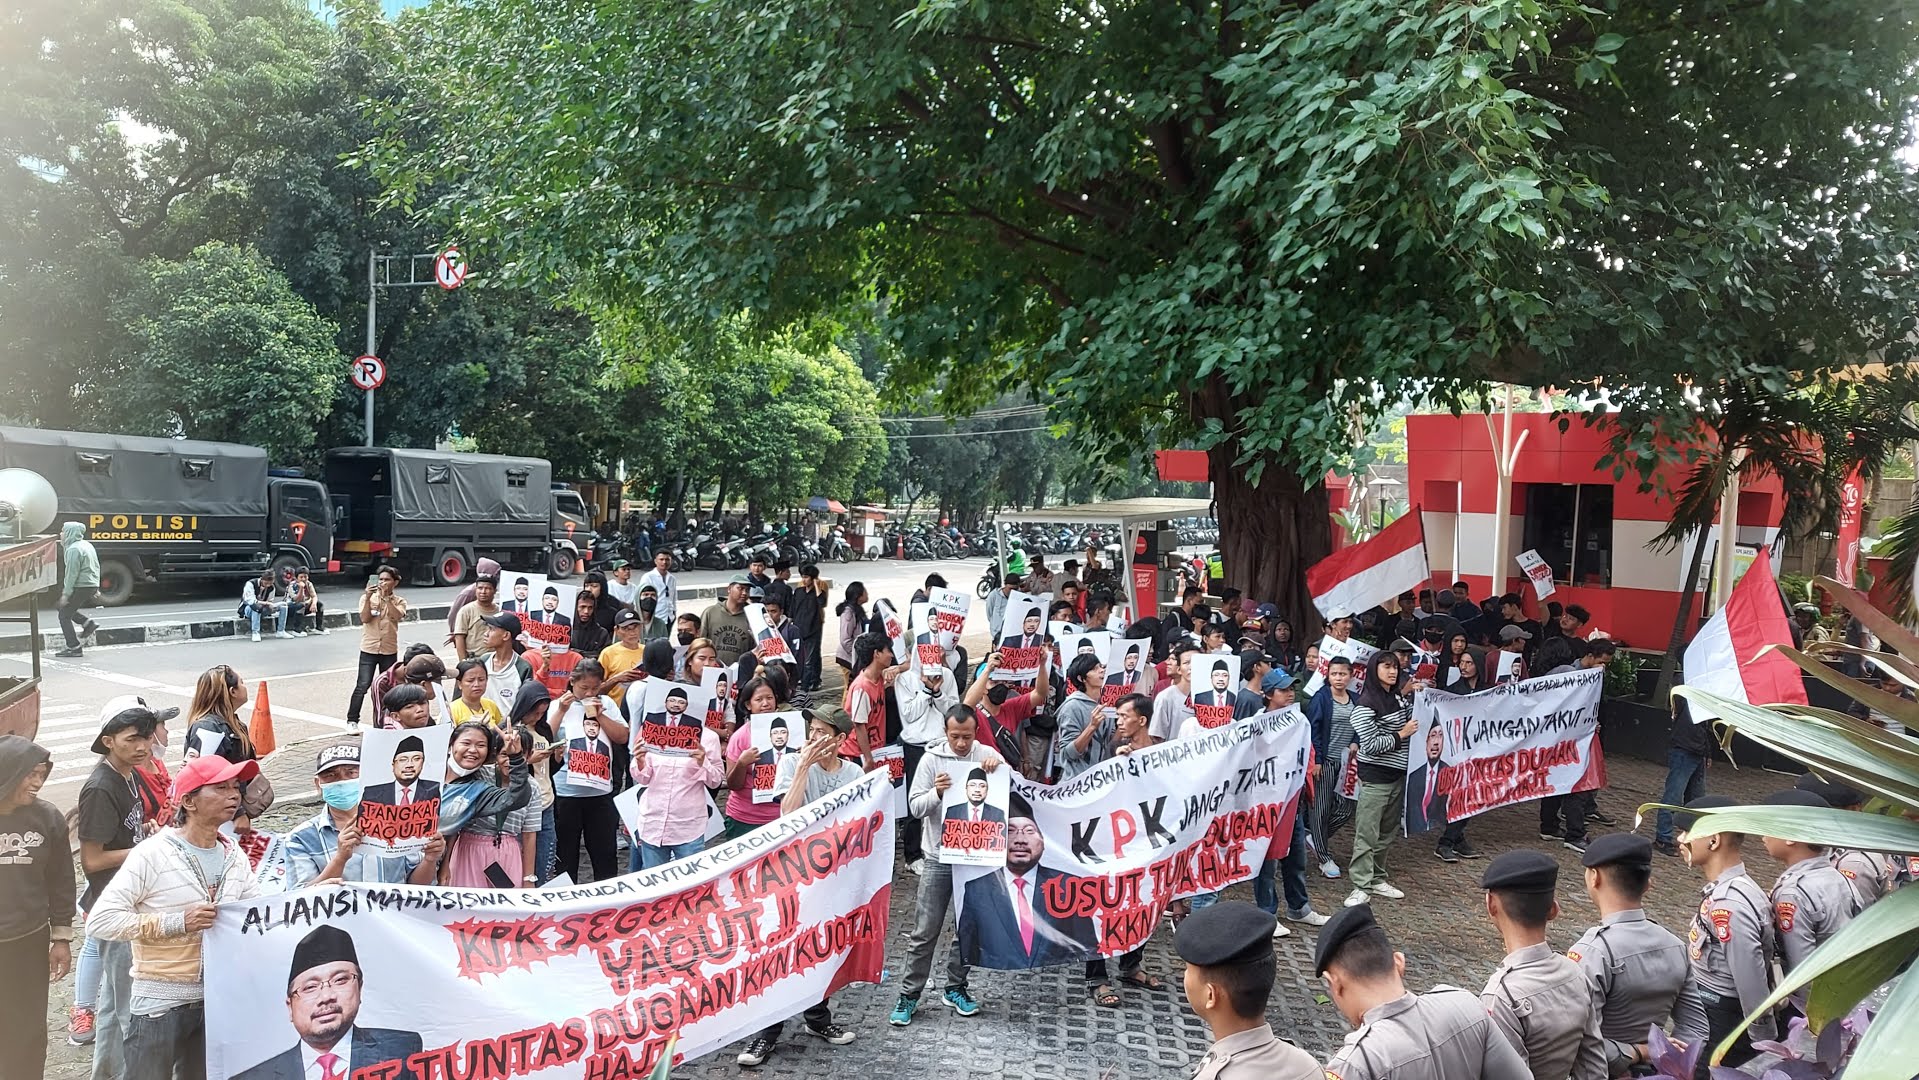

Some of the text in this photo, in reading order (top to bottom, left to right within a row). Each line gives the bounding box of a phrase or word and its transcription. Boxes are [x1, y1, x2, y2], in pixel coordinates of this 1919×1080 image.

[89, 514, 198, 530] POLISI
[91, 532, 193, 540] KORPS BRIMOB
[942, 594, 960, 604] KPK
[645, 722, 701, 738] TANGKAP
[571, 750, 610, 768] TANGKAP
[1129, 758, 1140, 778] &
[1142, 743, 1191, 772] PEMUDA
[1194, 729, 1236, 756] UNTUK
[362, 800, 439, 822] TANGKAP
[946, 820, 1004, 837] TANGKAP
[1071, 795, 1176, 864] KPK
[241, 778, 877, 935] ALIANSI MAHASISWA & PEMUDA UNTUK KEADILAN RAKYAT
[457, 812, 883, 972] KPK SEGERA TANGKAP
[1049, 872, 1142, 914] USUT
[1711, 909, 1729, 917] POLDA
[412, 910, 874, 1080] TUNTAS DUGAAN KKN KUOTA
